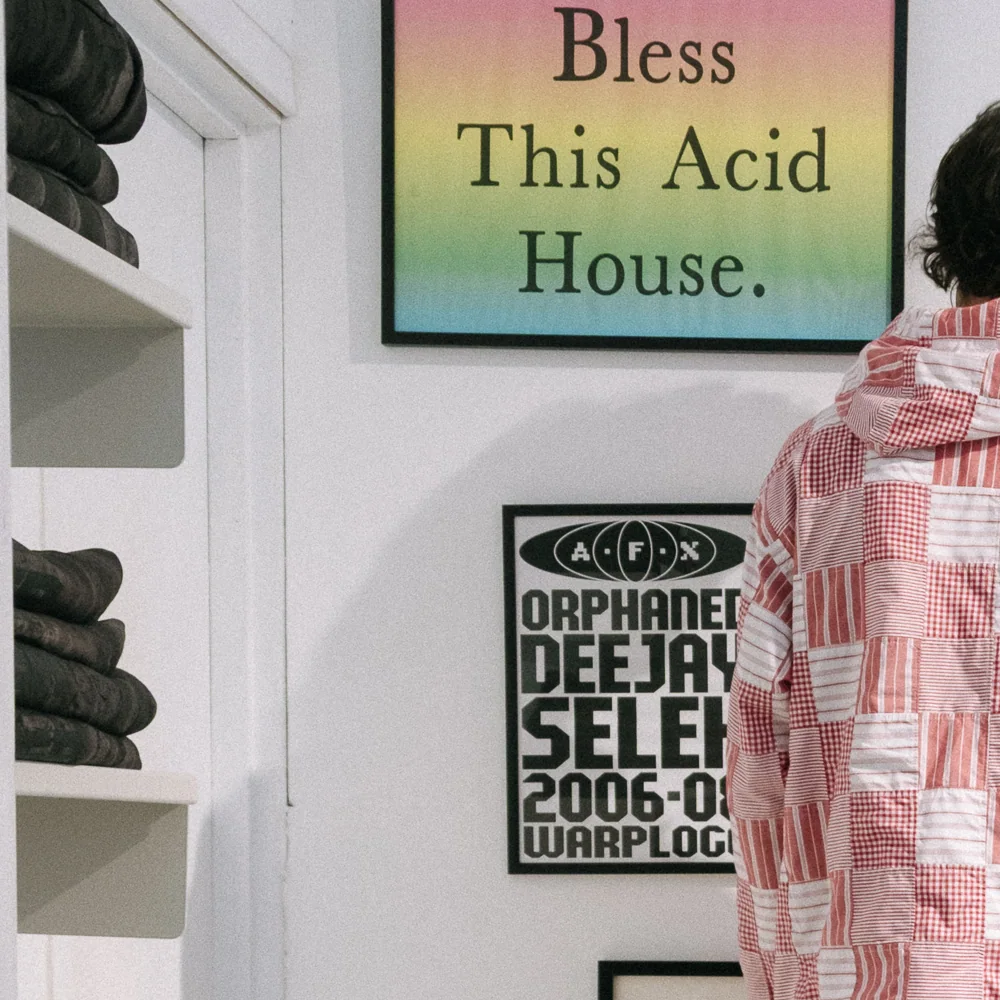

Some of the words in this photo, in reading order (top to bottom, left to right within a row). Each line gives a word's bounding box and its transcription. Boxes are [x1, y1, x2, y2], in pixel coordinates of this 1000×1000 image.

[553, 6, 736, 84] Bless
[457, 123, 621, 190] This
[661, 125, 831, 193] Acid
[518, 230, 766, 298] House.
[523, 825, 733, 859] WARPLOG
